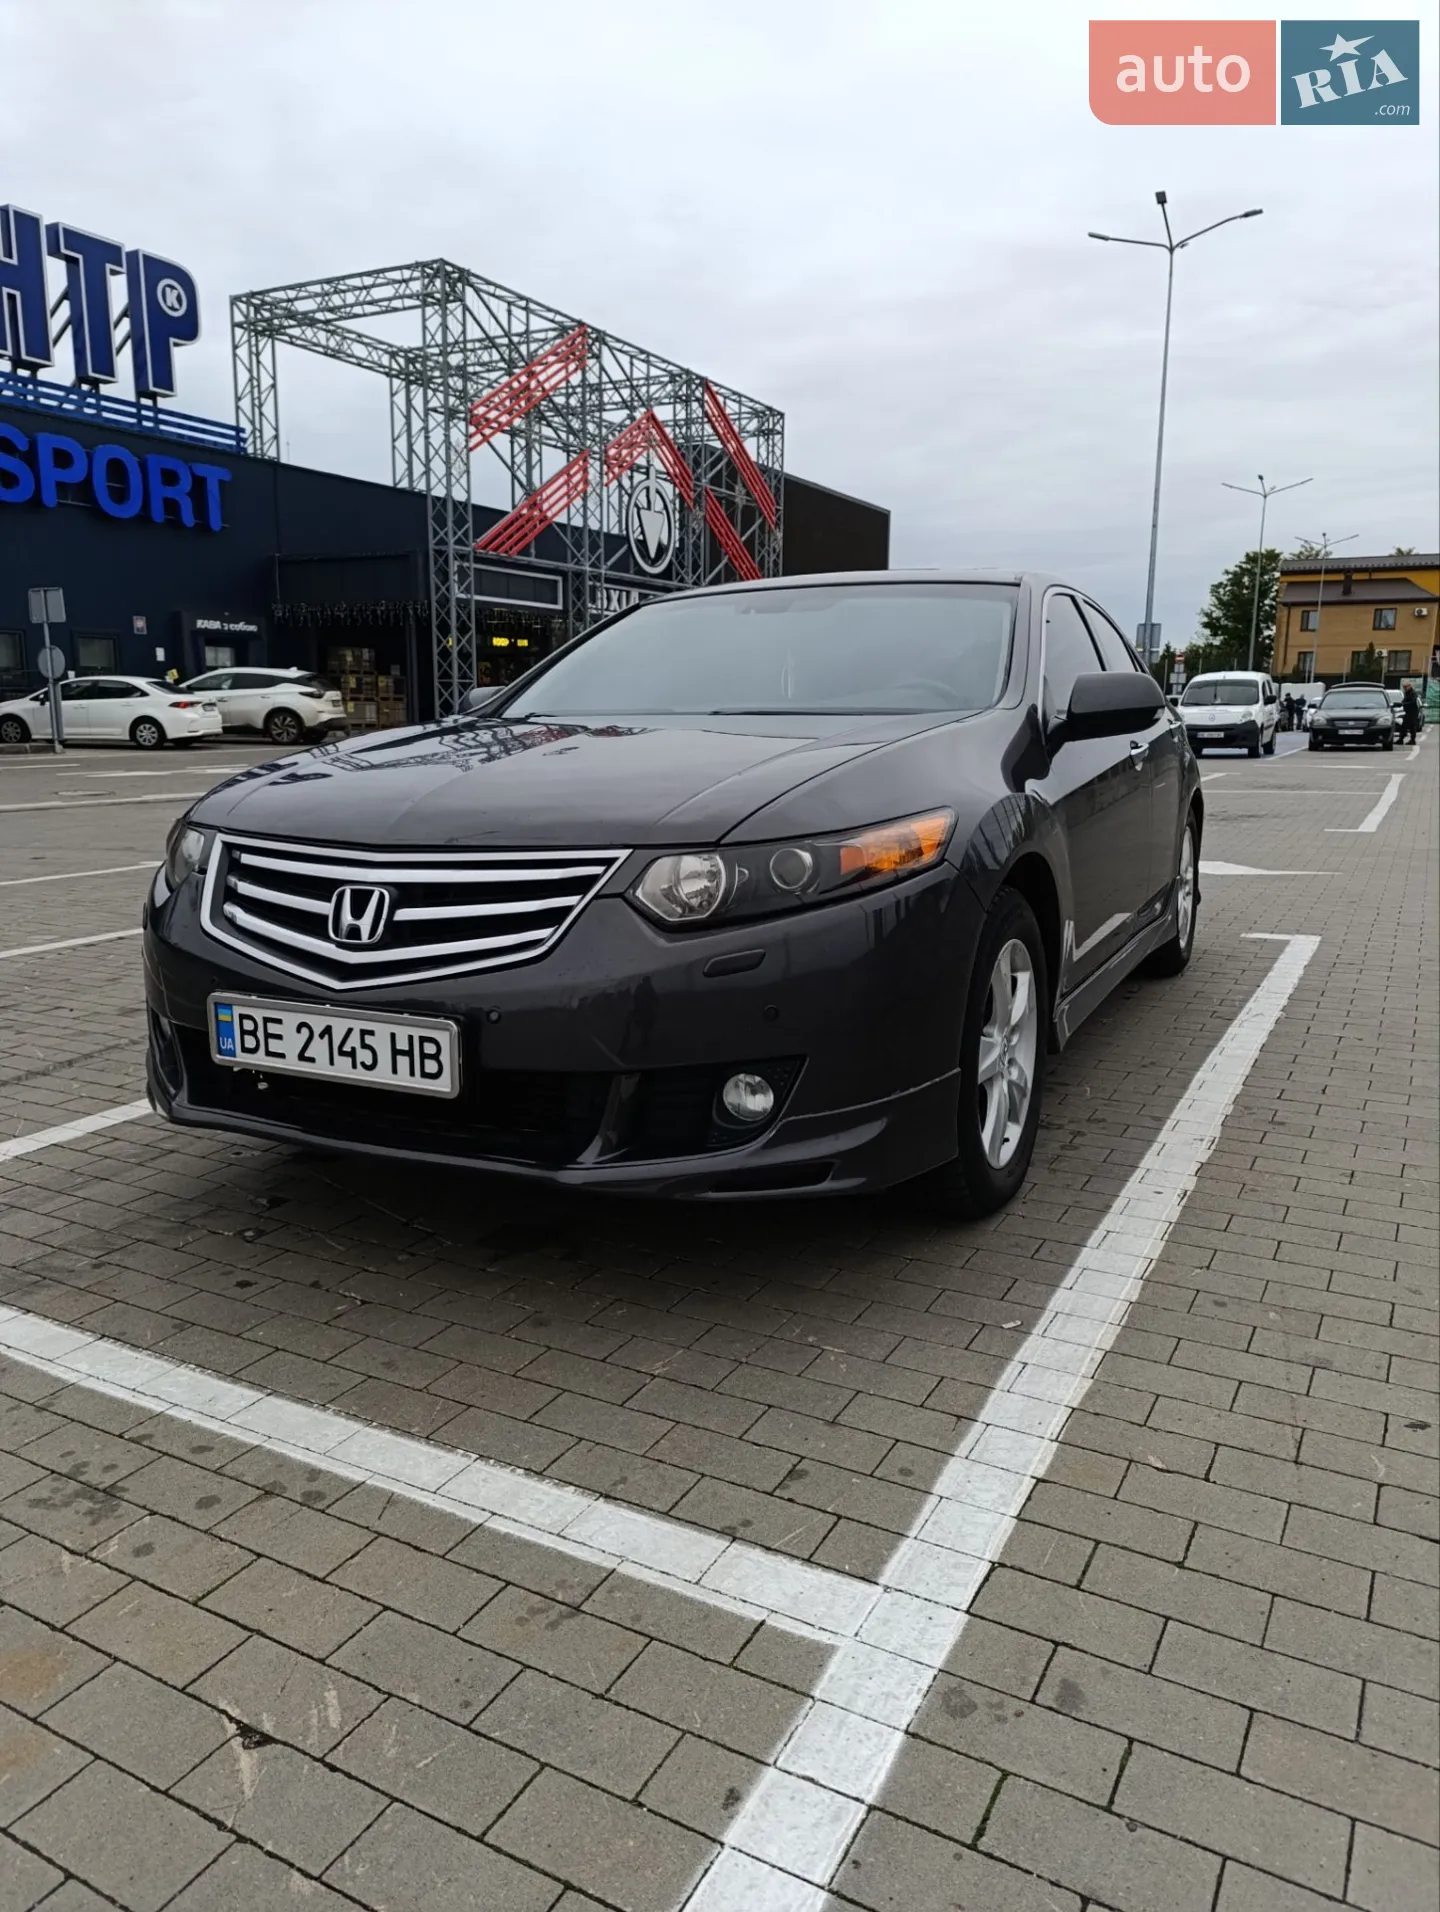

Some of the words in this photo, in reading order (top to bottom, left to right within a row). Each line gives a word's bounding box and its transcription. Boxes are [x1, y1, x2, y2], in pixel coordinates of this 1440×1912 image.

[0, 422, 233, 532] SPORT
[219, 1036, 234, 1051] UA
[238, 1013, 286, 1060] BE
[296, 1021, 378, 1071] 2145
[390, 1031, 444, 1080] HB
